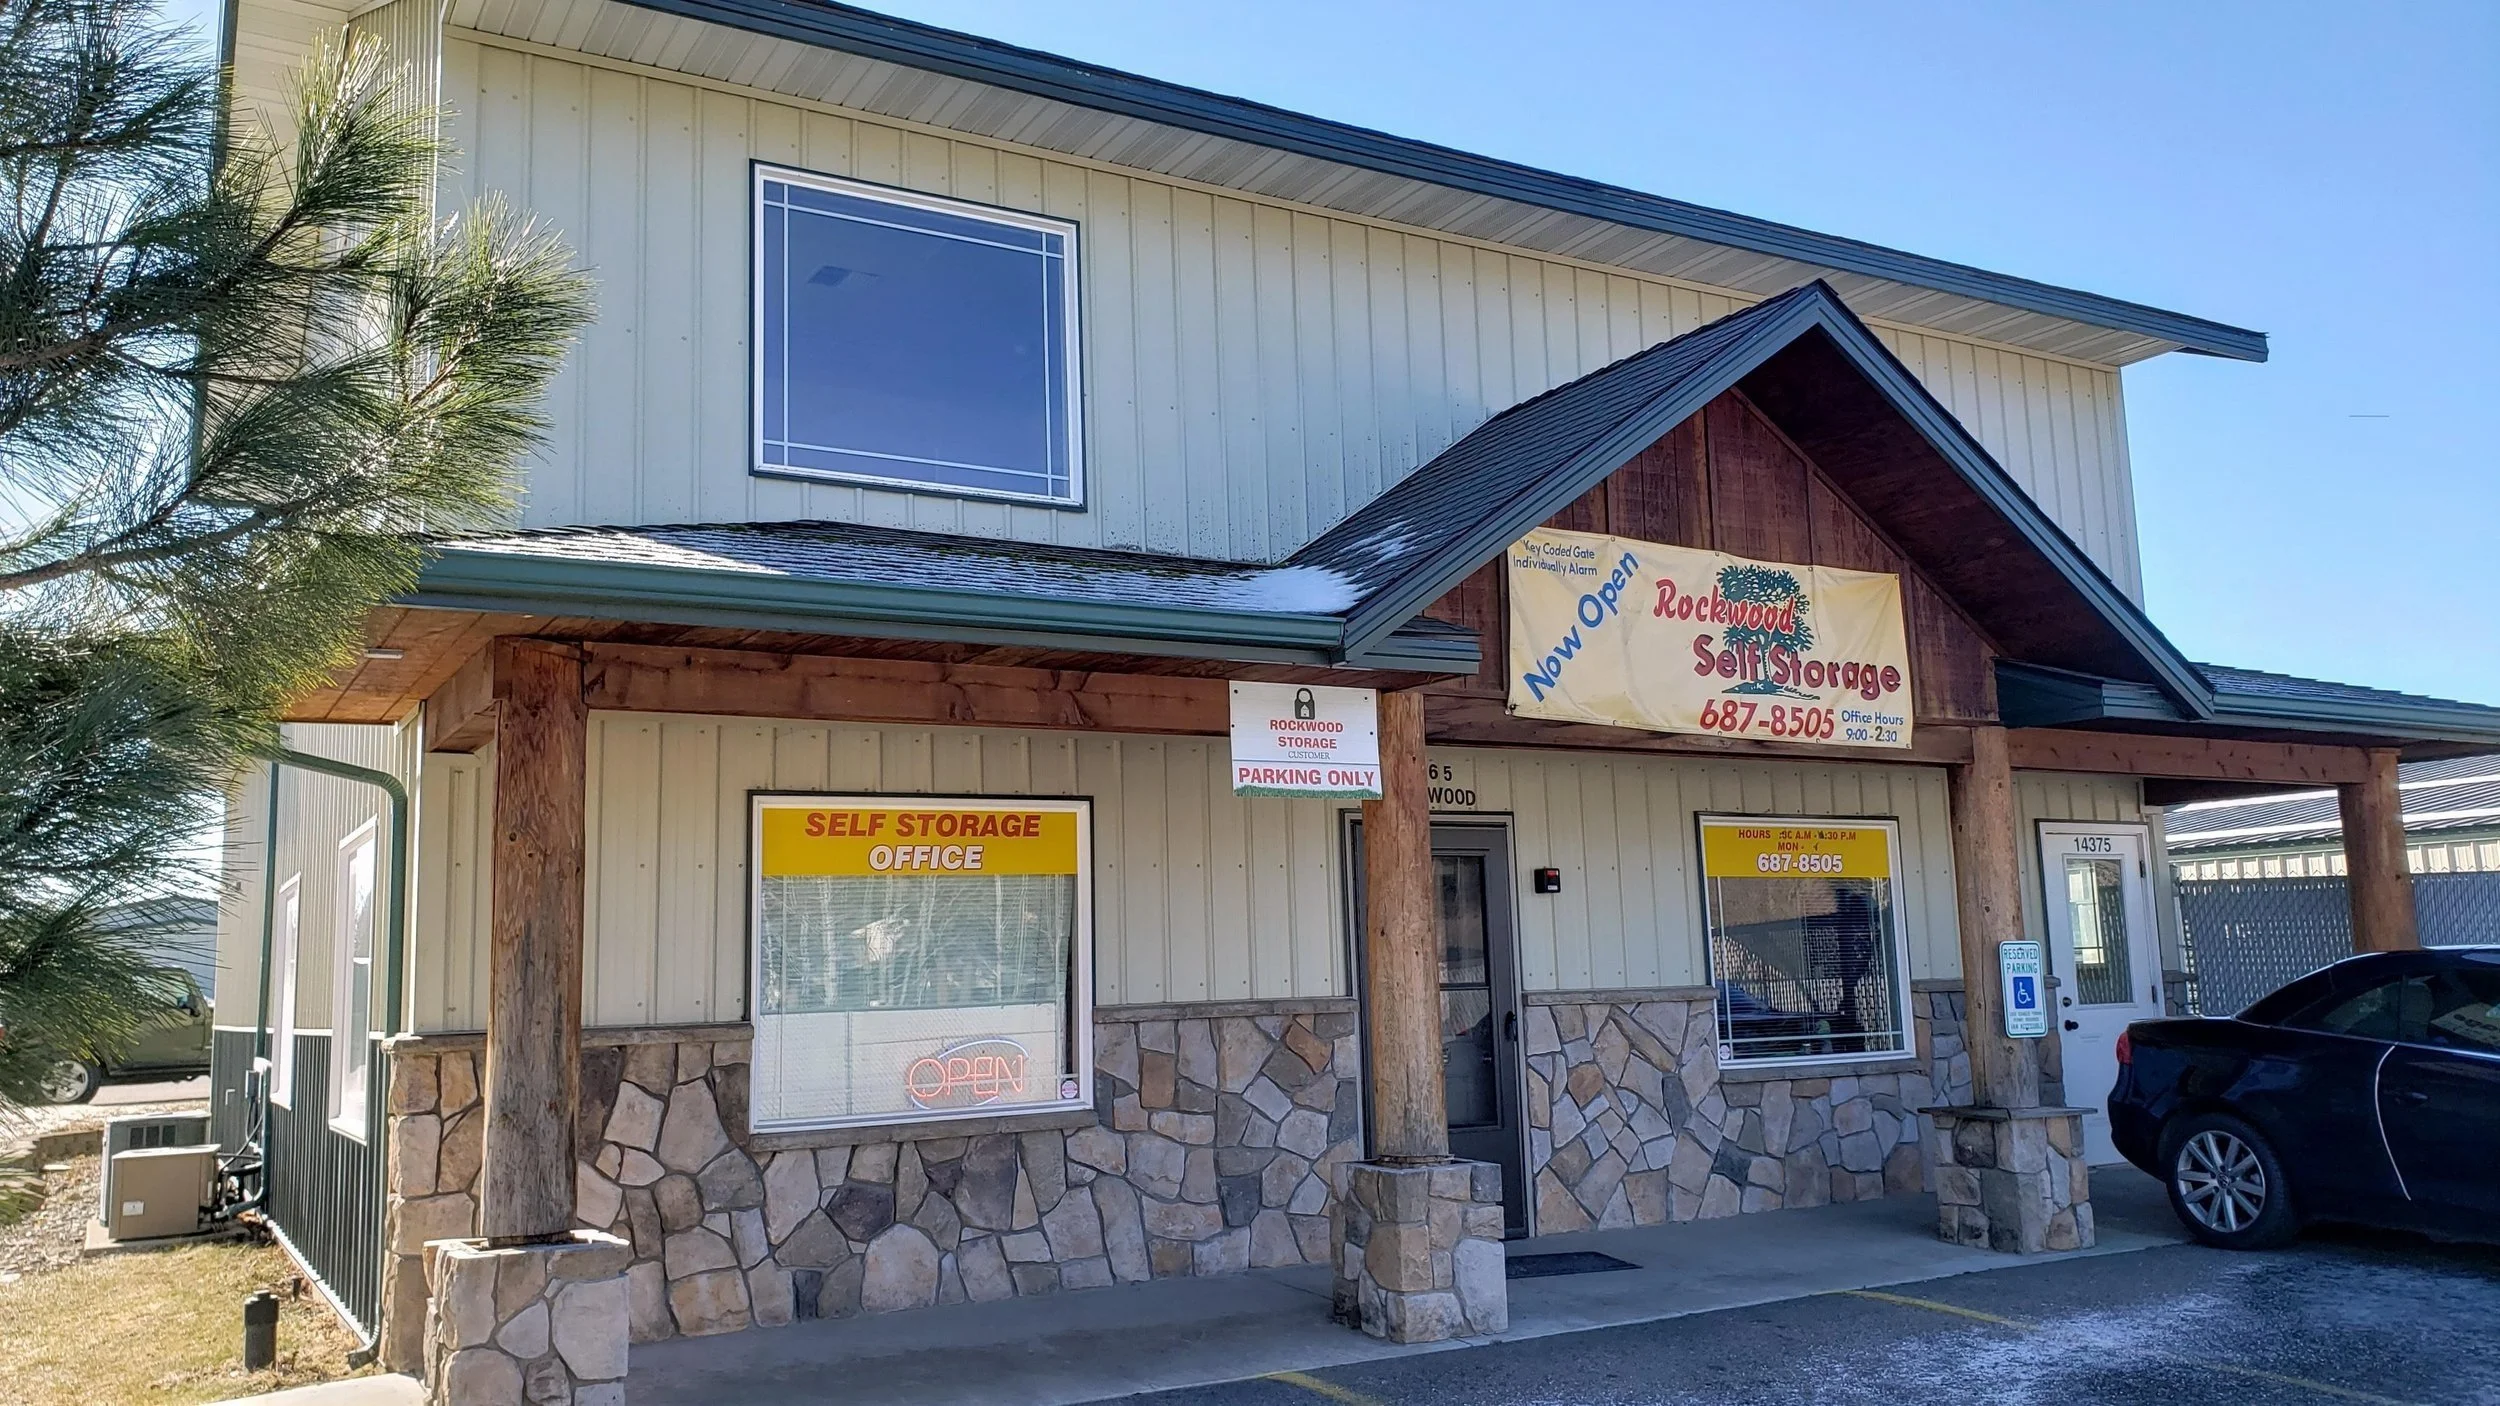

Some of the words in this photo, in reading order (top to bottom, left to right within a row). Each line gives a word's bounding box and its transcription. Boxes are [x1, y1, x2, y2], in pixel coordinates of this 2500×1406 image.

[1523, 539, 1541, 556] Key
[1543, 542, 1572, 558] Coded
[1573, 545, 1595, 560] Gate
[1513, 555, 1567, 577] Individually
[1568, 563, 1598, 577] Alarm
[1653, 578, 1795, 633] Rockwood
[1522, 624, 1582, 703] Now
[1577, 551, 1639, 629] Open
[1692, 634, 1762, 682] Self
[1768, 643, 1901, 701] Storage
[1269, 719, 1344, 733] ROCKWOOD
[1699, 698, 1835, 740] 687-8505
[1841, 709, 1873, 724] Office
[1874, 710, 1904, 726] Hours
[1277, 736, 1338, 749] STORAGE
[1287, 751, 1331, 760] CUSTOMER
[1238, 767, 1322, 786] PARKING
[1327, 770, 1375, 787] ONLY
[1428, 763, 1453, 782] 65
[1427, 786, 1476, 806] WOOD
[804, 812, 887, 837] SELF
[895, 813, 1042, 838] STORAGE
[1738, 829, 1771, 839] HOURS
[1777, 842, 1799, 851] MON
[2073, 837, 2112, 853] 14375
[868, 844, 985, 871] OFFICE
[1757, 852, 1843, 873] 687-8505
[2003, 948, 2038, 960] RESERVED
[2006, 962, 2038, 974] PARKING
[908, 1054, 1026, 1099] OPEN
